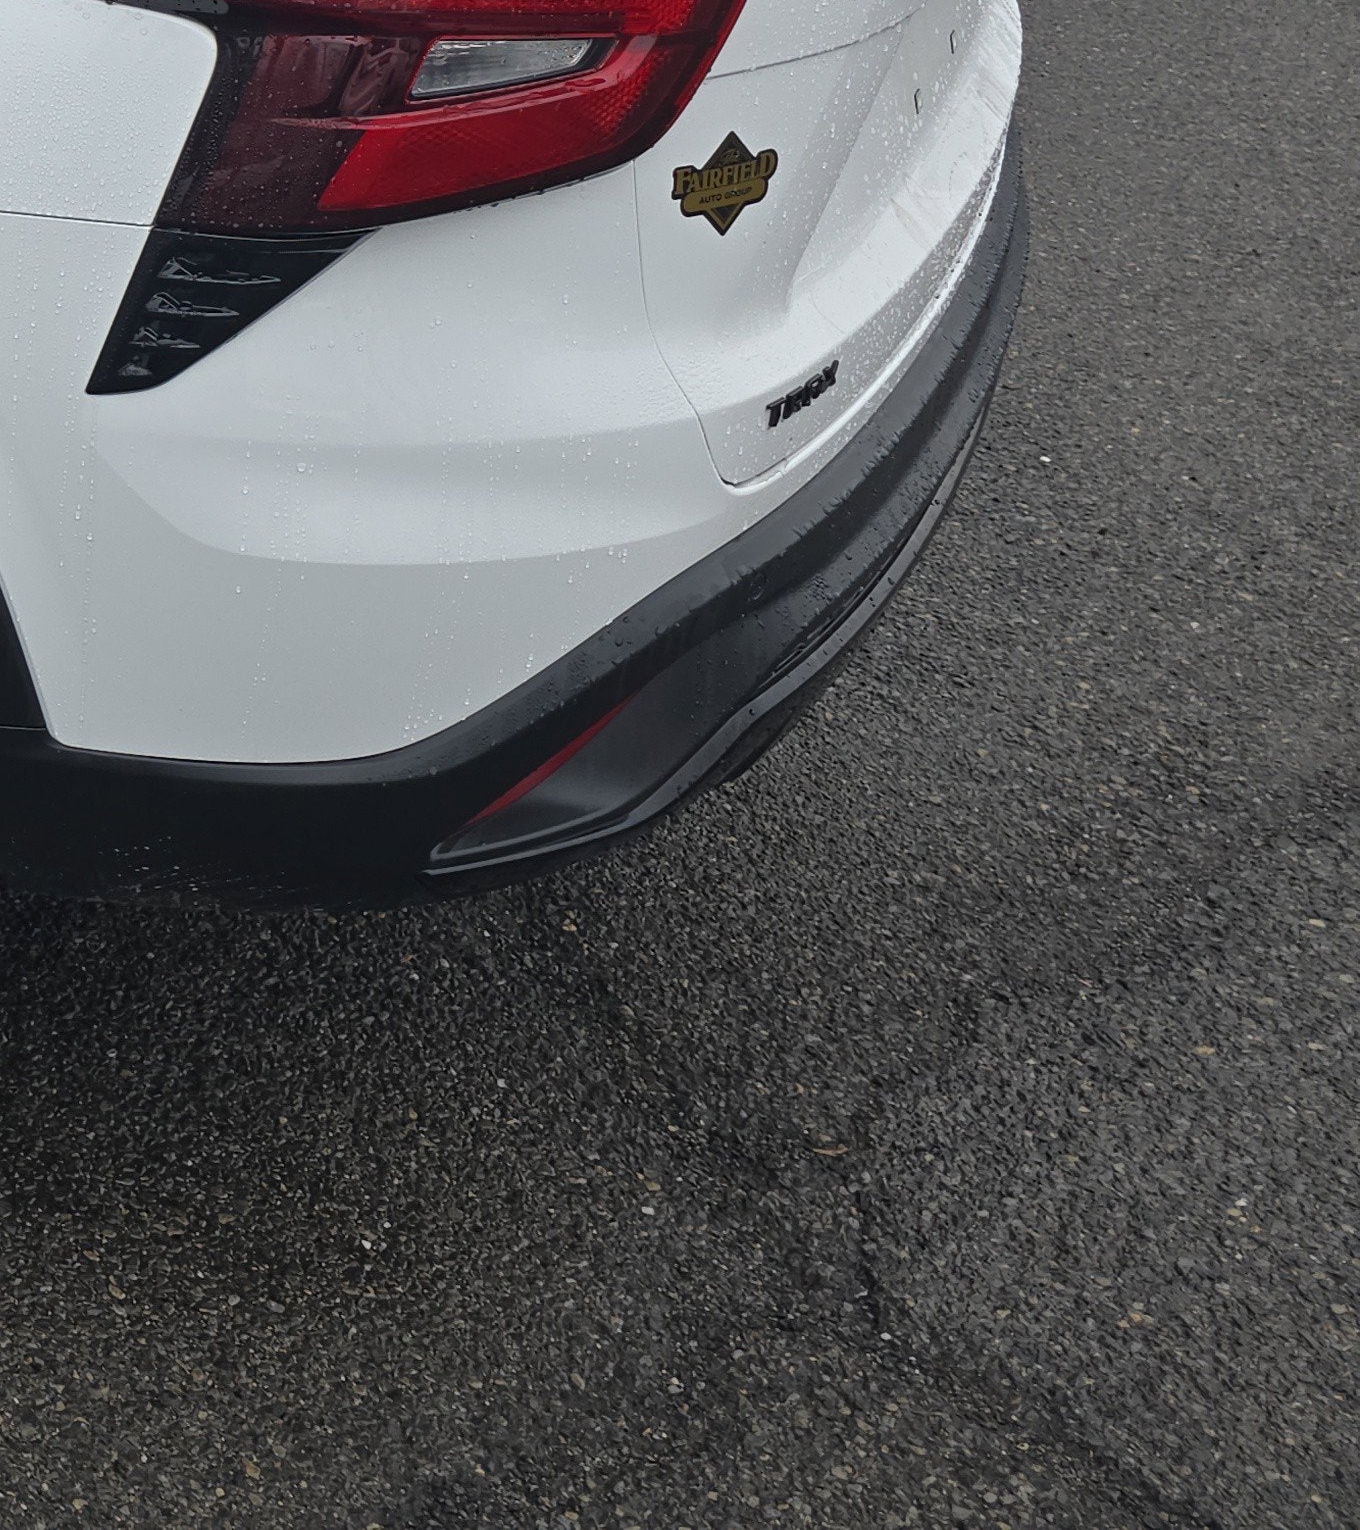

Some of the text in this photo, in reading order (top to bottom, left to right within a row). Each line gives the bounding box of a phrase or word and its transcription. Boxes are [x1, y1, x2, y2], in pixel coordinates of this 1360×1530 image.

[674, 151, 777, 195] FAIRFIELD
[699, 193, 722, 205] AUTO
[765, 359, 839, 427] TRAX
